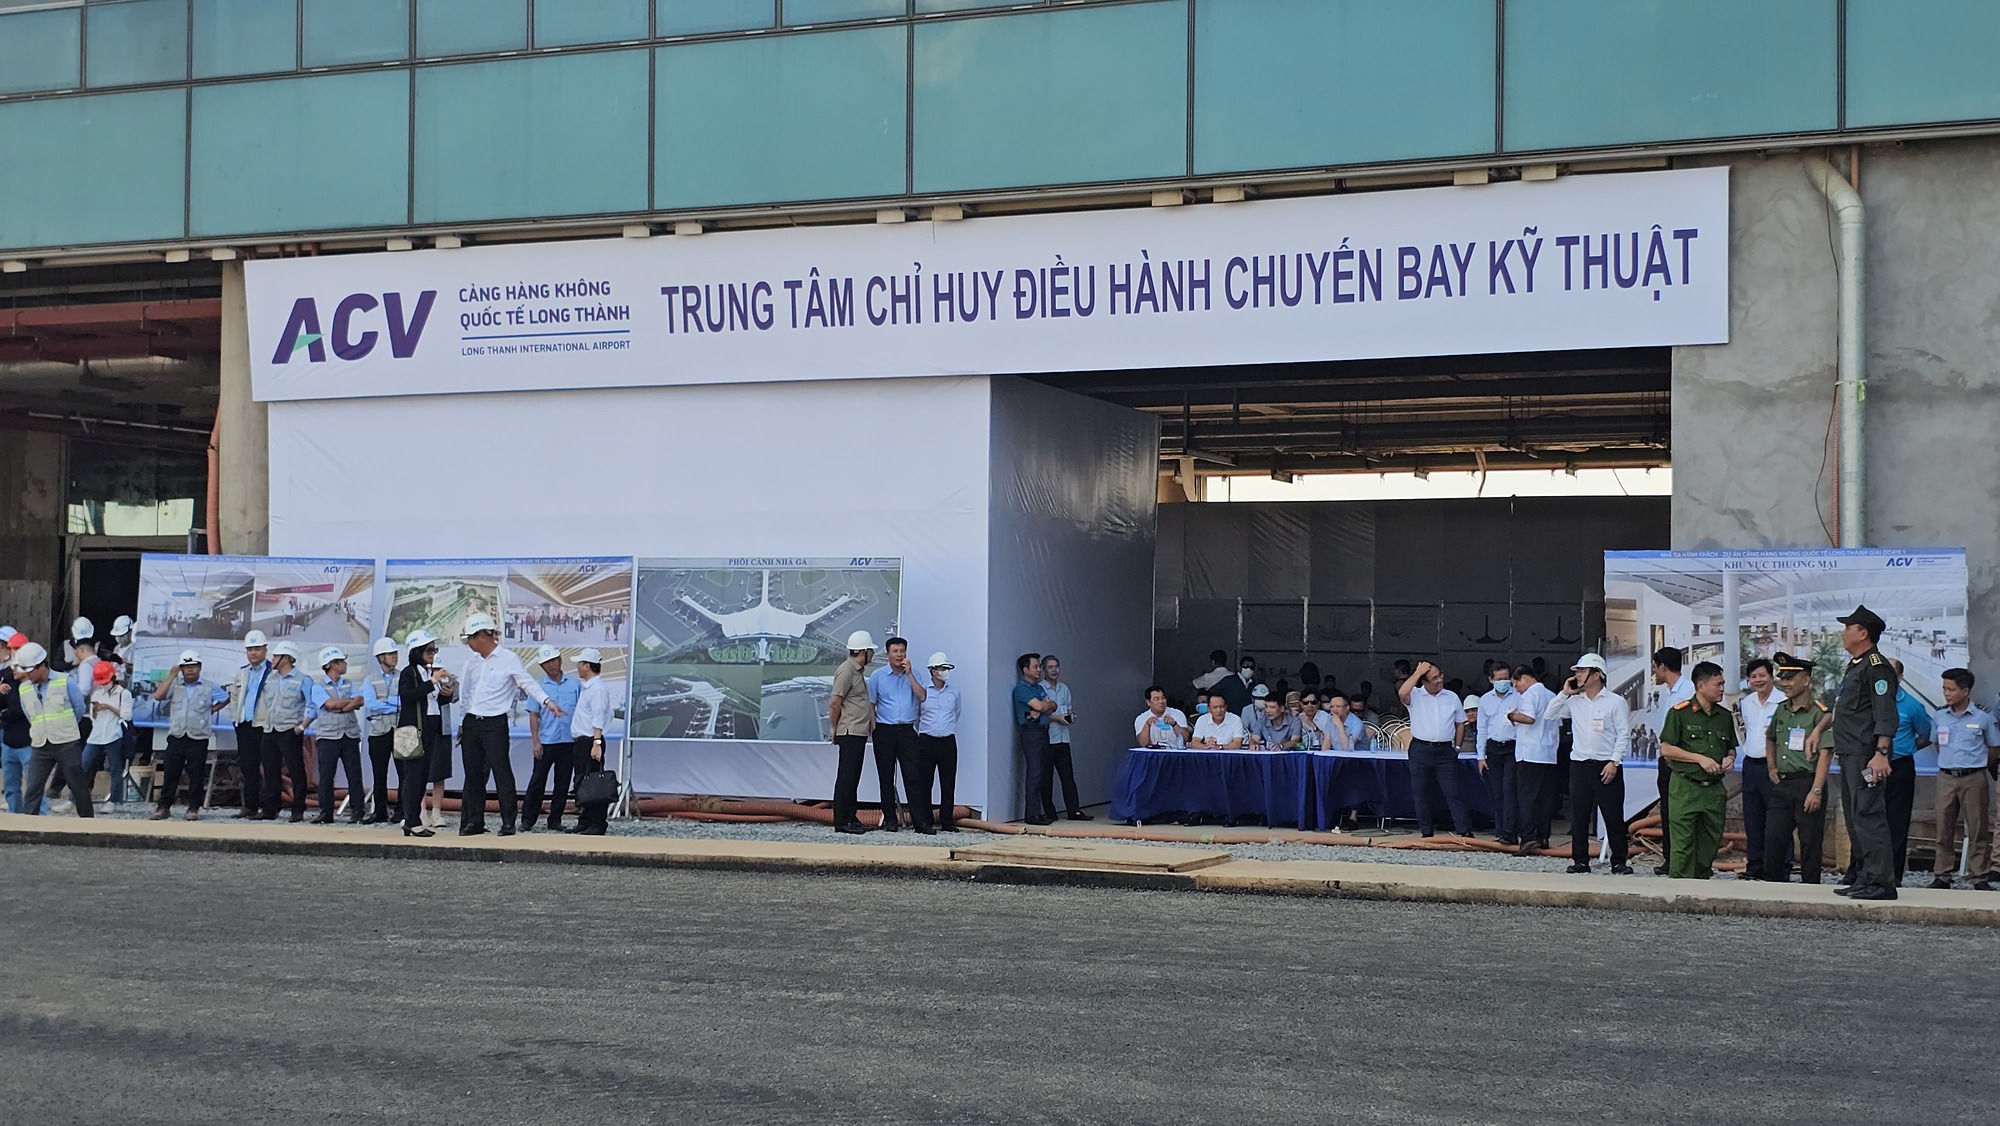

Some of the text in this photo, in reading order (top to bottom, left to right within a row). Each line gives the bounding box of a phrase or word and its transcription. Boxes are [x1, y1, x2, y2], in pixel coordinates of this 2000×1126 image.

[661, 224, 1698, 334] TRUNG TÂM CHỈ HUY ĐIỀU HÀNH CHUYẾN BAY KỸ THUẬT
[459, 277, 611, 303] CẢNG HÀNG KHÔNG
[460, 302, 630, 331] QUỐC TẾ LONG THÀNH
[271, 289, 438, 364] ACV
[461, 340, 631, 357] LONG THANH INTERNATIONAL AIRPORT
[795, 558, 808, 566] GA
[850, 557, 872, 566] ACV
[1724, 561, 1744, 569] KHU
[1818, 560, 1838, 570] MẠI
[1886, 557, 1913, 567] ACV
[324, 565, 342, 574] ACV
[578, 565, 598, 573] ACV
